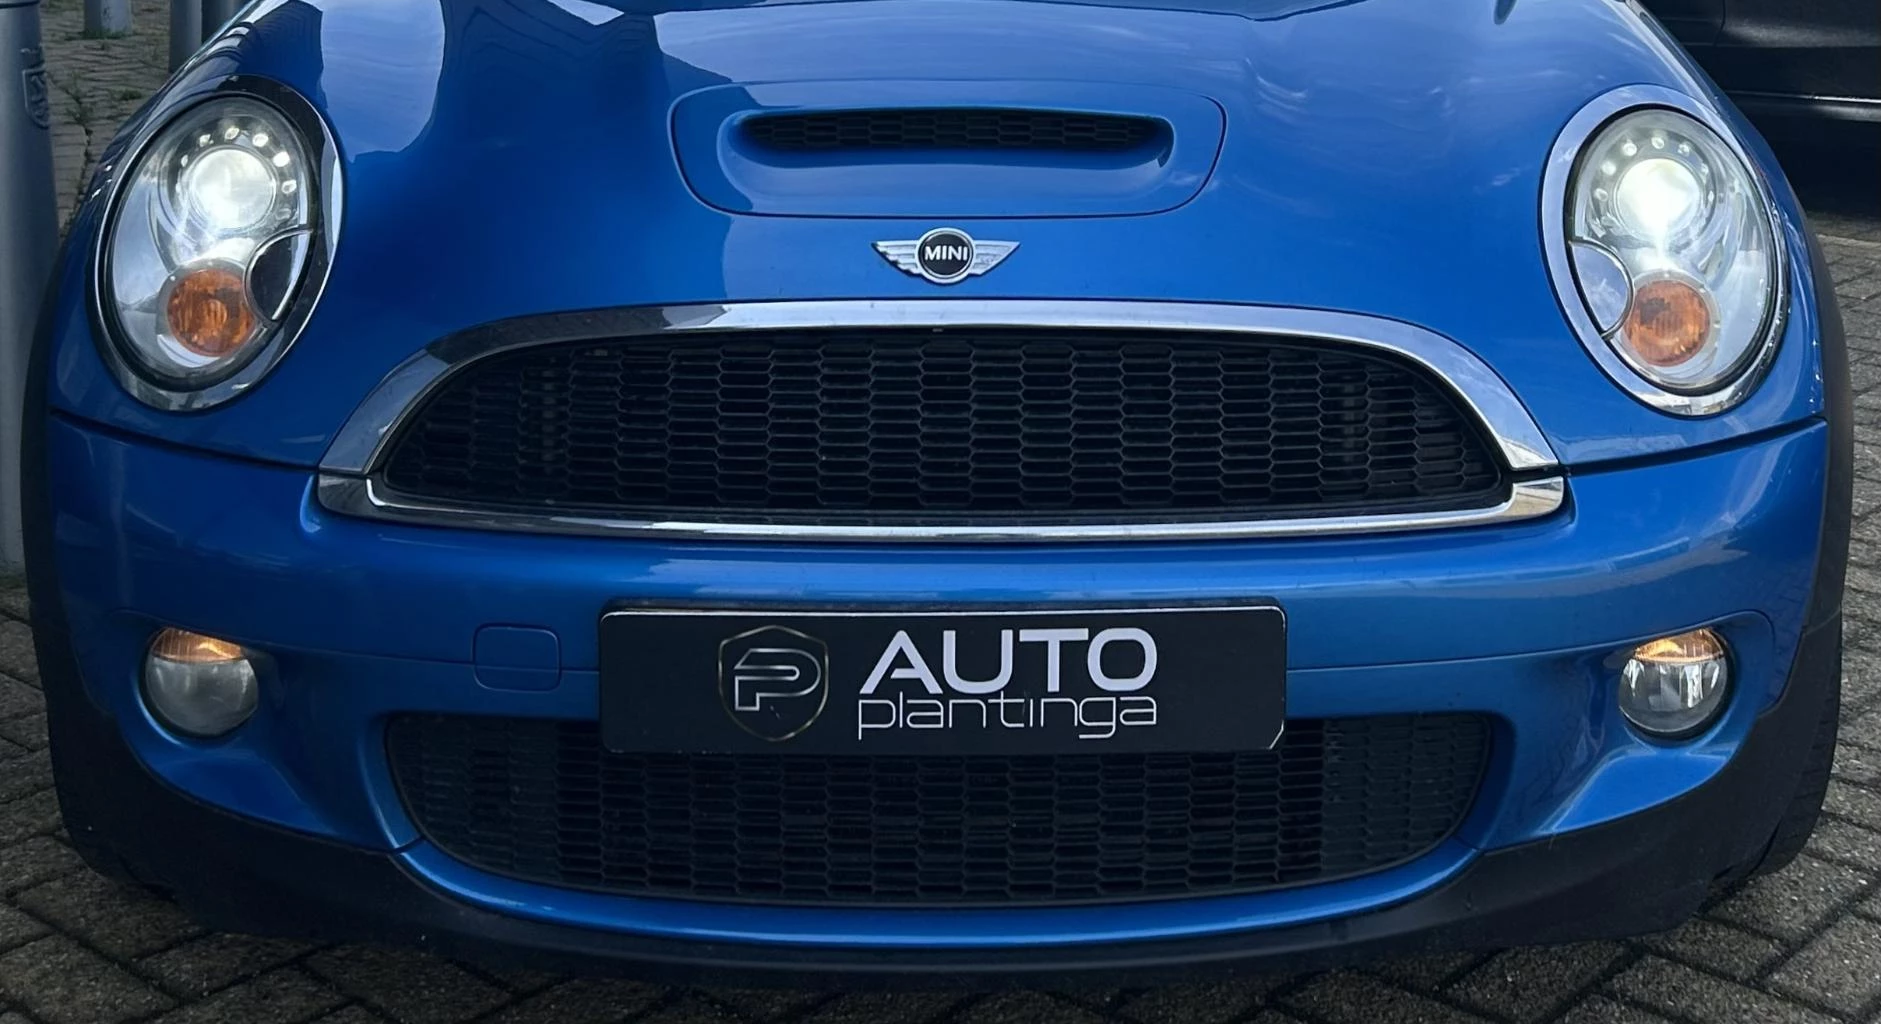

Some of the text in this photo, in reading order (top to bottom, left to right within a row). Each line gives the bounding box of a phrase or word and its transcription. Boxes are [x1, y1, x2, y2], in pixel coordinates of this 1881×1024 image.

[925, 245, 968, 261] MINI
[858, 627, 1157, 694] AUTO
[858, 690, 1158, 740] plantinga
